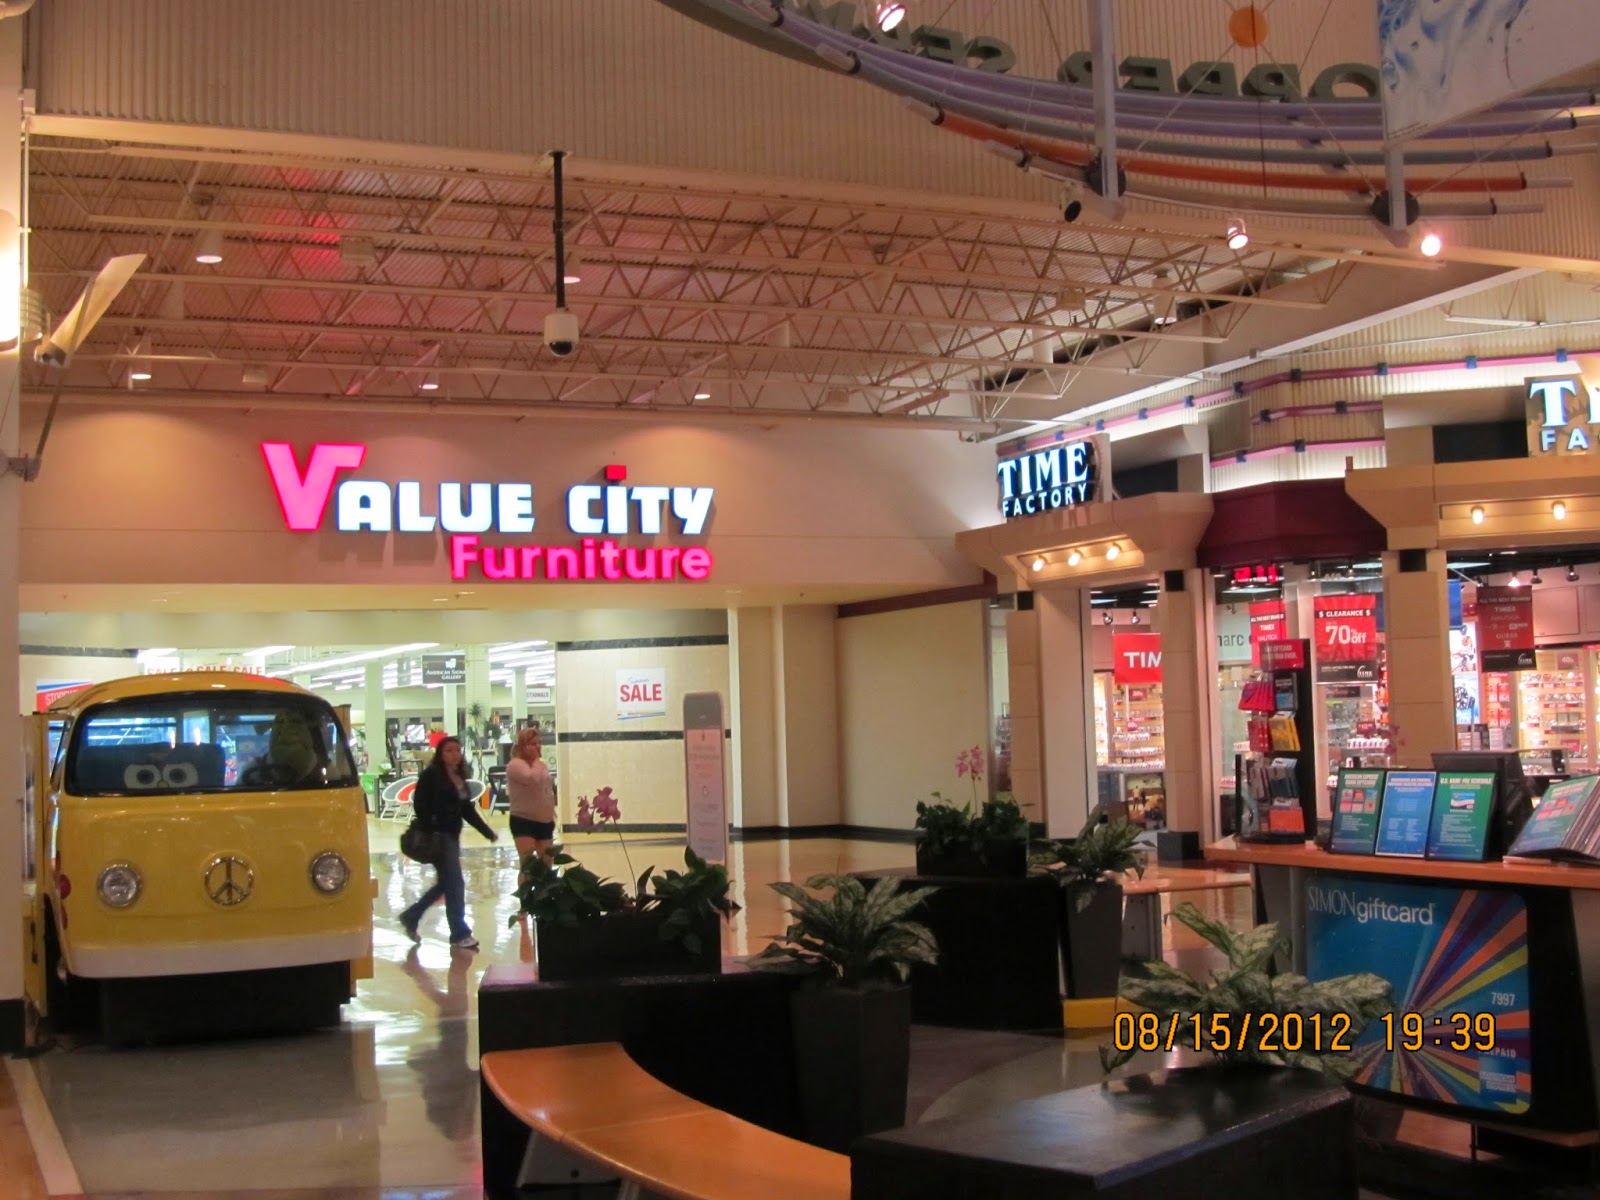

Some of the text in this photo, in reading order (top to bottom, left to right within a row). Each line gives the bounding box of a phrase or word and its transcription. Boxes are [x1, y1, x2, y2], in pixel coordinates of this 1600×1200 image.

[997, 441, 1090, 499] TIME
[261, 442, 535, 534] VALUE
[1002, 482, 1088, 517] FACTORY
[450, 534, 713, 581] Furniture
[1326, 609, 1364, 617] CLEARANCE
[619, 683, 663, 702] SALE
[1491, 992, 1516, 1007] 7997
